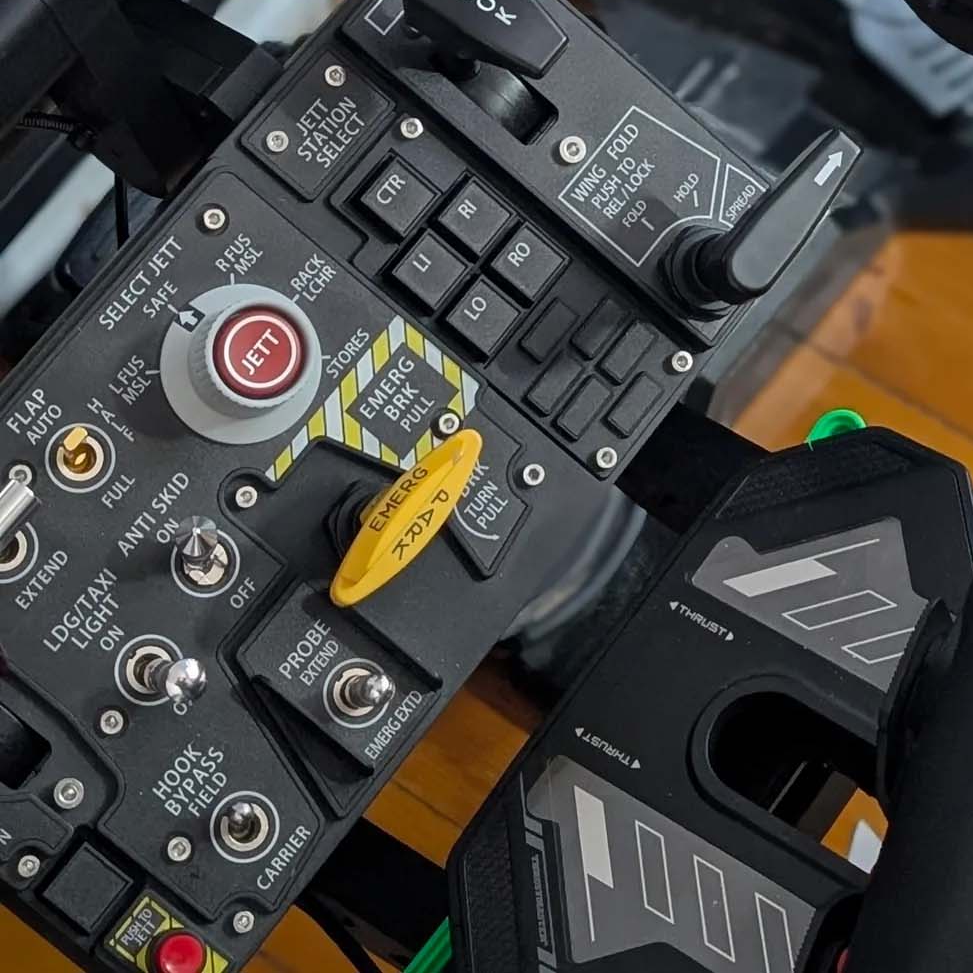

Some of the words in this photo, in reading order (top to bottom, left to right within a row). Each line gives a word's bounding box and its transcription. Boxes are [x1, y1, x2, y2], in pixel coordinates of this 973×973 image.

[295, 97, 329, 137] JETT
[297, 96, 358, 162] STATION
[316, 112, 365, 169] SELECT
[570, 163, 607, 203] WING
[606, 123, 639, 160] FOLD
[591, 174, 622, 210] PUSH
[616, 157, 636, 176] TO
[376, 173, 407, 205] CTR
[602, 158, 656, 220] REL/LOCK
[673, 172, 700, 203] HOLD
[725, 184, 756, 222] SPREAD
[457, 198, 479, 220] RI
[621, 199, 647, 228] FOLD
[214, 257, 230, 273] R
[224, 233, 252, 263] FUS
[234, 248, 264, 276] MSL
[290, 253, 326, 292] RACK
[507, 242, 531, 268] RO
[99, 270, 153, 331] SELECT
[147, 235, 184, 278] JETT
[142, 280, 179, 319] SAFE
[302, 265, 337, 303] LCHR
[463, 296, 487, 322] LO
[240, 328, 281, 377] JETT
[326, 328, 371, 380] STORES
[108, 381, 123, 395] L
[117, 354, 146, 385] FUS
[121, 373, 153, 406] MSL
[359, 354, 416, 420] EMERG
[6, 388, 48, 435] FLAP
[86, 397, 136, 443] HALF
[383, 380, 421, 422] BRK
[400, 398, 436, 433] PULL
[25, 404, 63, 446] AUTO
[101, 474, 136, 510] FULL
[369, 466, 429, 532] EMERG
[463, 480, 499, 519] TURN
[117, 511, 157, 558] ANTI
[151, 472, 190, 515] SKID
[156, 517, 181, 544] ON
[392, 489, 450, 562] PARK
[476, 496, 509, 530] PULL
[14, 550, 69, 610] EXTEND
[229, 577, 258, 610] OFF
[42, 567, 118, 653] LDG/TAXI
[71, 593, 121, 650] LIGHT
[678, 604, 729, 637] THRUST
[98, 625, 126, 652] ON
[278, 618, 332, 680] PROBE
[299, 640, 340, 687] EXTEND
[364, 717, 401, 761] EMERG
[394, 690, 424, 722] EXTD
[581, 732, 632, 767] THRUST
[152, 743, 203, 801] HOOK
[164, 746, 225, 817] BYPASS
[188, 771, 228, 818] FIELD
[256, 825, 312, 891] CARRIER
[120, 920, 143, 946] PUSH
[137, 908, 153, 924] TO
[134, 919, 156, 947] JETT
